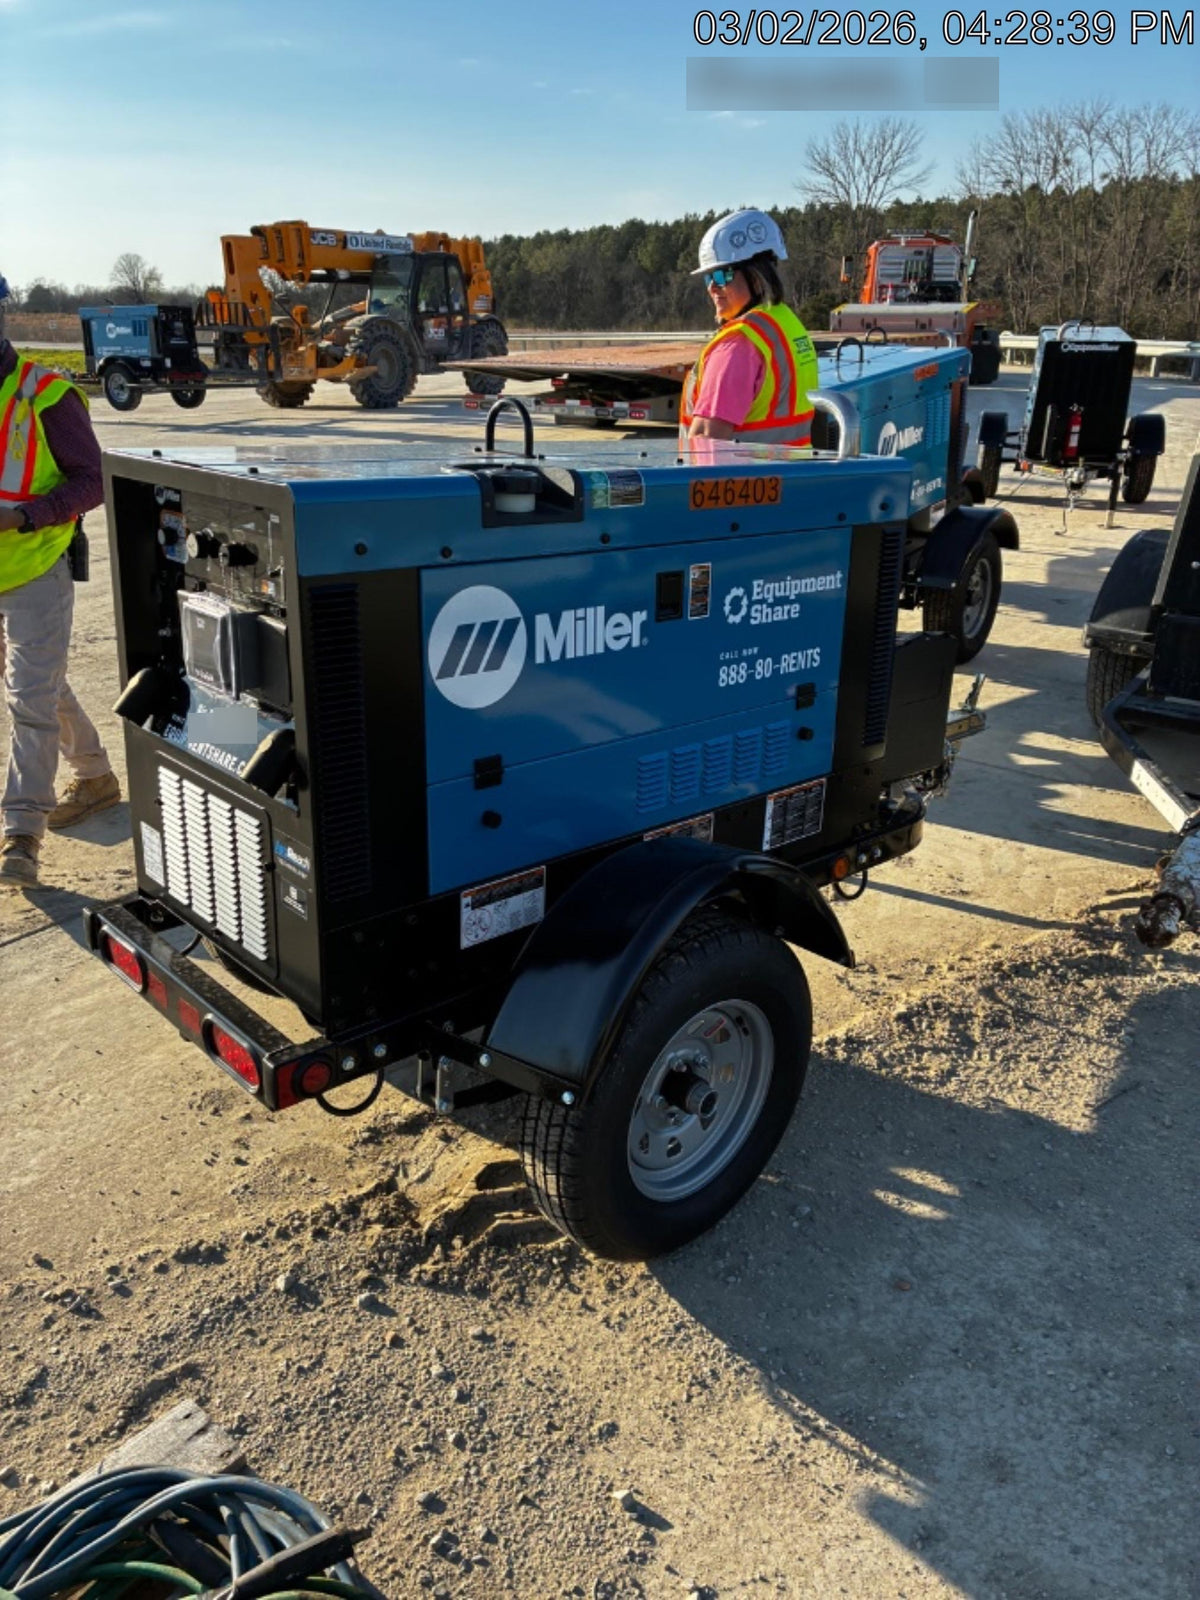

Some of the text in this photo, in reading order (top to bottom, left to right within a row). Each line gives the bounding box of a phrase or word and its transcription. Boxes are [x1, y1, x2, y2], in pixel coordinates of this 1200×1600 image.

[311, 231, 337, 247] JCB
[692, 476, 780, 508] 646403
[751, 570, 843, 603] Equipment
[750, 603, 800, 625] Share
[534, 605, 648, 664] Miller
[718, 646, 821, 687] 888-80-RENTS
